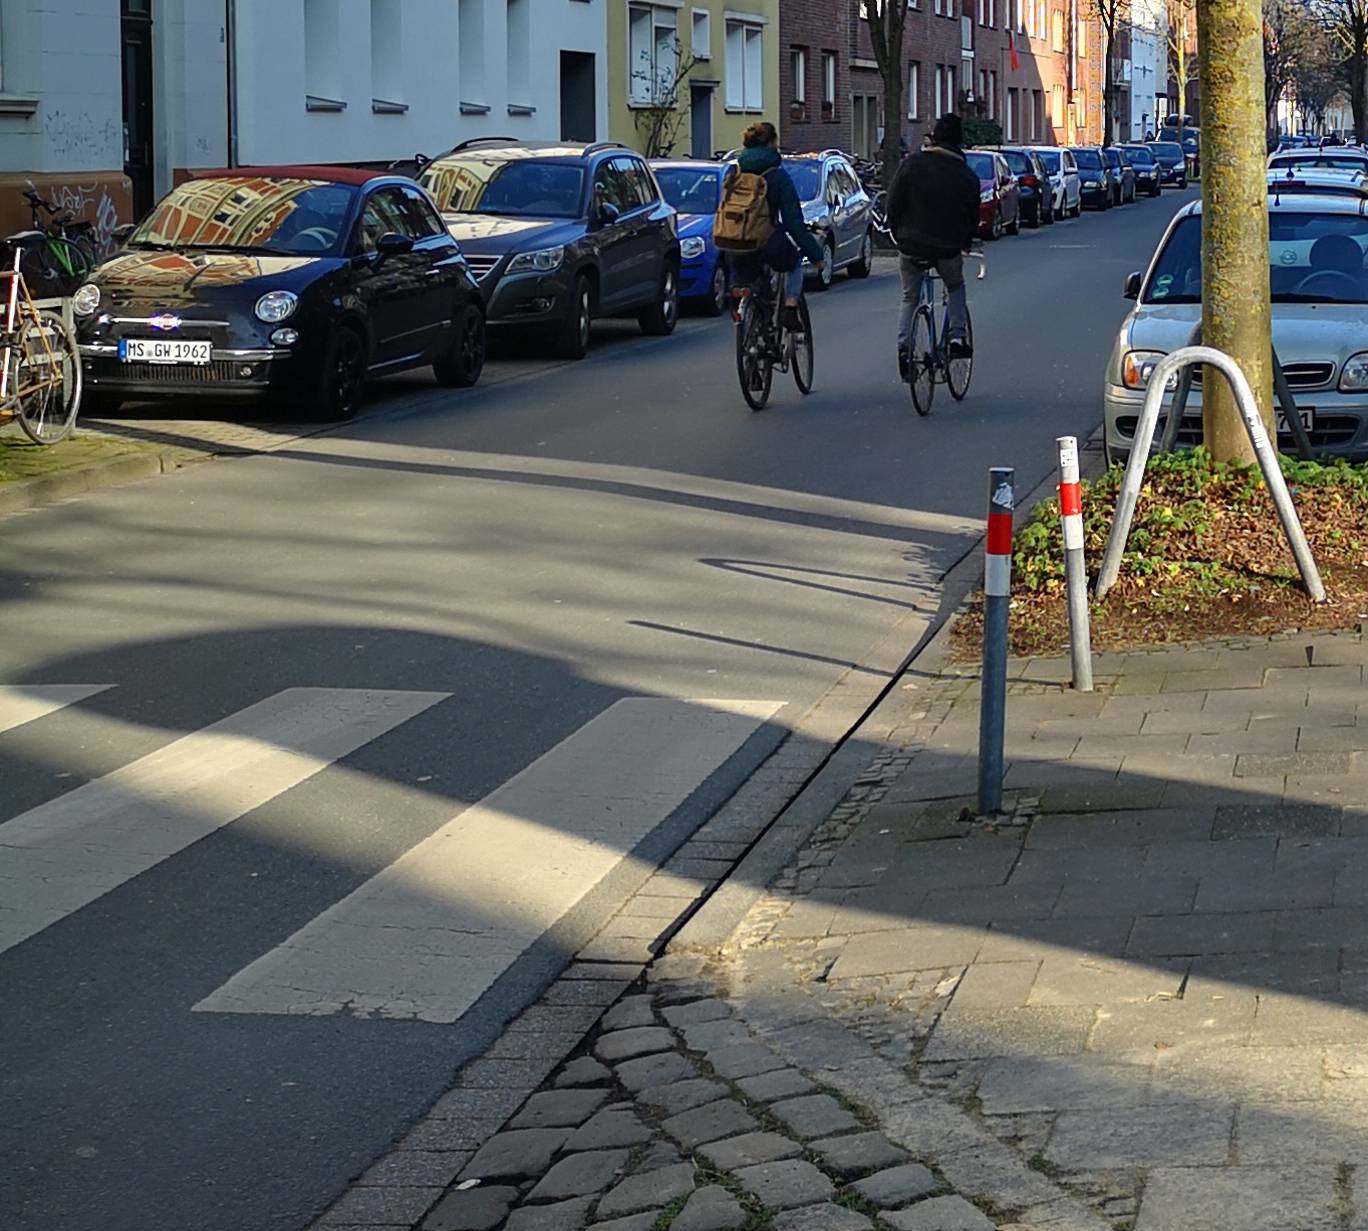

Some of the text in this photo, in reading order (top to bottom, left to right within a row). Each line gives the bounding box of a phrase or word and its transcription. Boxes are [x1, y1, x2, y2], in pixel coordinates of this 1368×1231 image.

[128, 343, 207, 359] MS GW 1962
